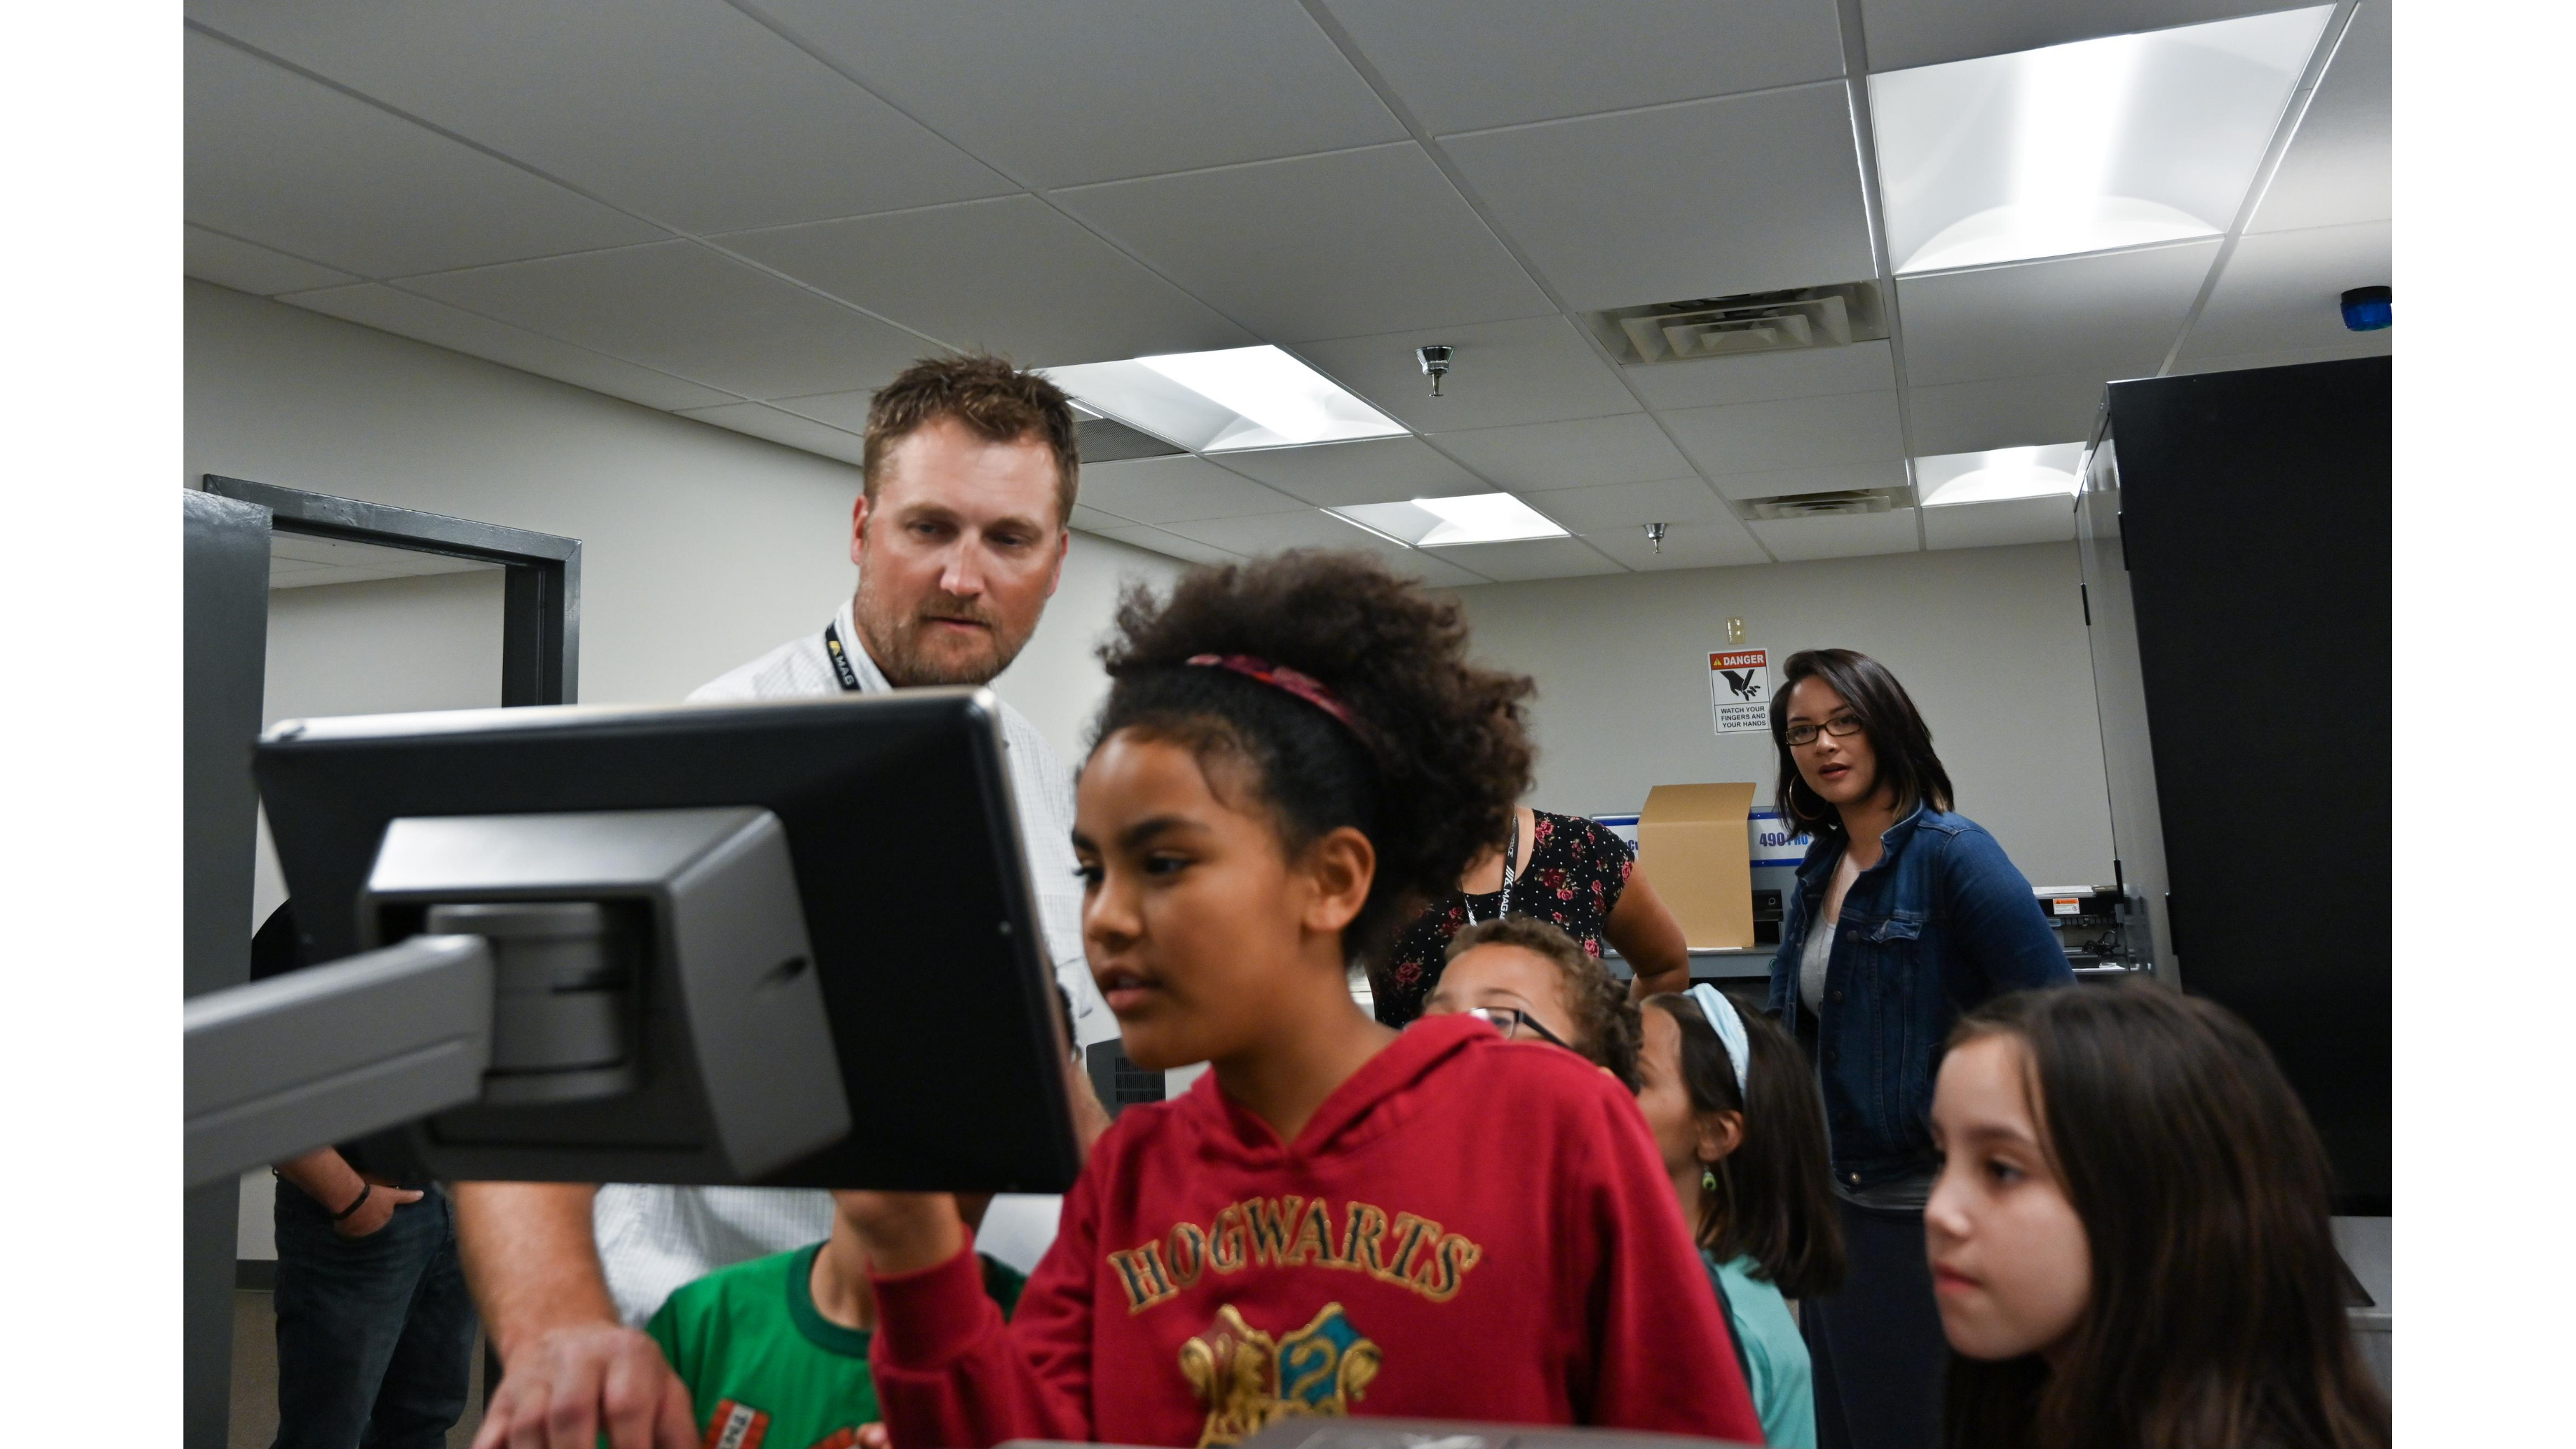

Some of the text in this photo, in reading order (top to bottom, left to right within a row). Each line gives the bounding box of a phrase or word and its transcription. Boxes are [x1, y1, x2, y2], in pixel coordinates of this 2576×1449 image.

[1723, 654, 1764, 665] DANGER
[1759, 831, 1786, 847] 490
[1107, 1194, 1483, 1314] HOGWARTS
